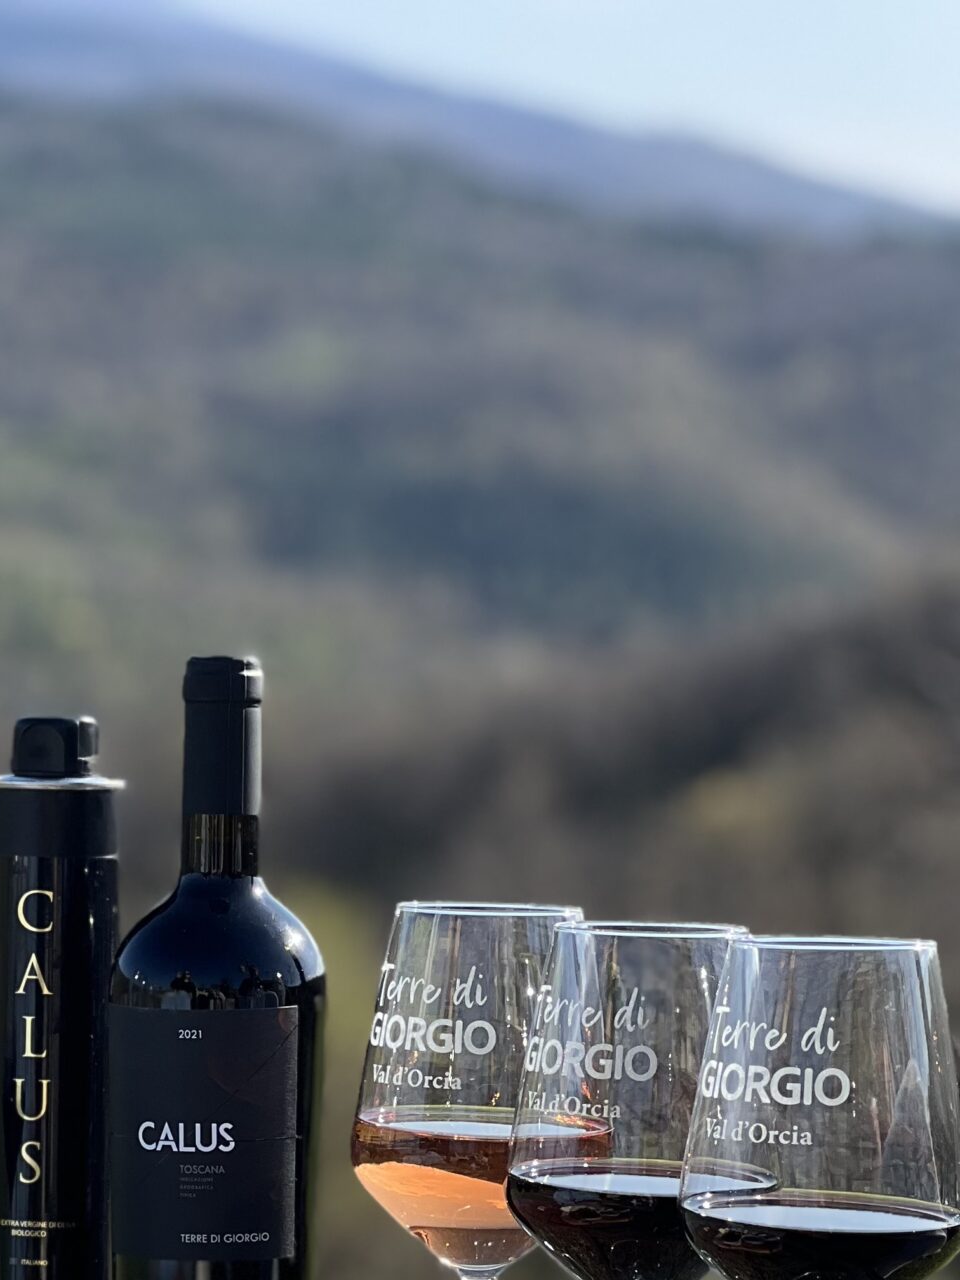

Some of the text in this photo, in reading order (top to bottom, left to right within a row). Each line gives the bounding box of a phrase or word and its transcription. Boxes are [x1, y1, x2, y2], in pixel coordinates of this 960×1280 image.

[380, 962, 488, 1009] Terre di
[536, 985, 650, 1033] Terre di
[12, 889, 54, 1184] CALUS
[178, 1029, 203, 1039] 2021
[370, 1011, 497, 1056] GIORGIO
[712, 1006, 841, 1055] Terre di
[525, 1035, 658, 1082] GIORGIO
[372, 1063, 391, 1085] Val
[701, 1060, 851, 1107] GIORGIO
[527, 1090, 545, 1112] Val
[138, 1120, 236, 1153] CALUS
[705, 1117, 726, 1140] Val
[179, 1164, 225, 1174] TOSCANA
[1, 1219, 19, 1227] EXTRA
[20, 1220, 47, 1228] VERGINE
[11, 1229, 47, 1238] BIOLOGICO
[180, 1232, 270, 1243] TERRE DI GIORGIO
